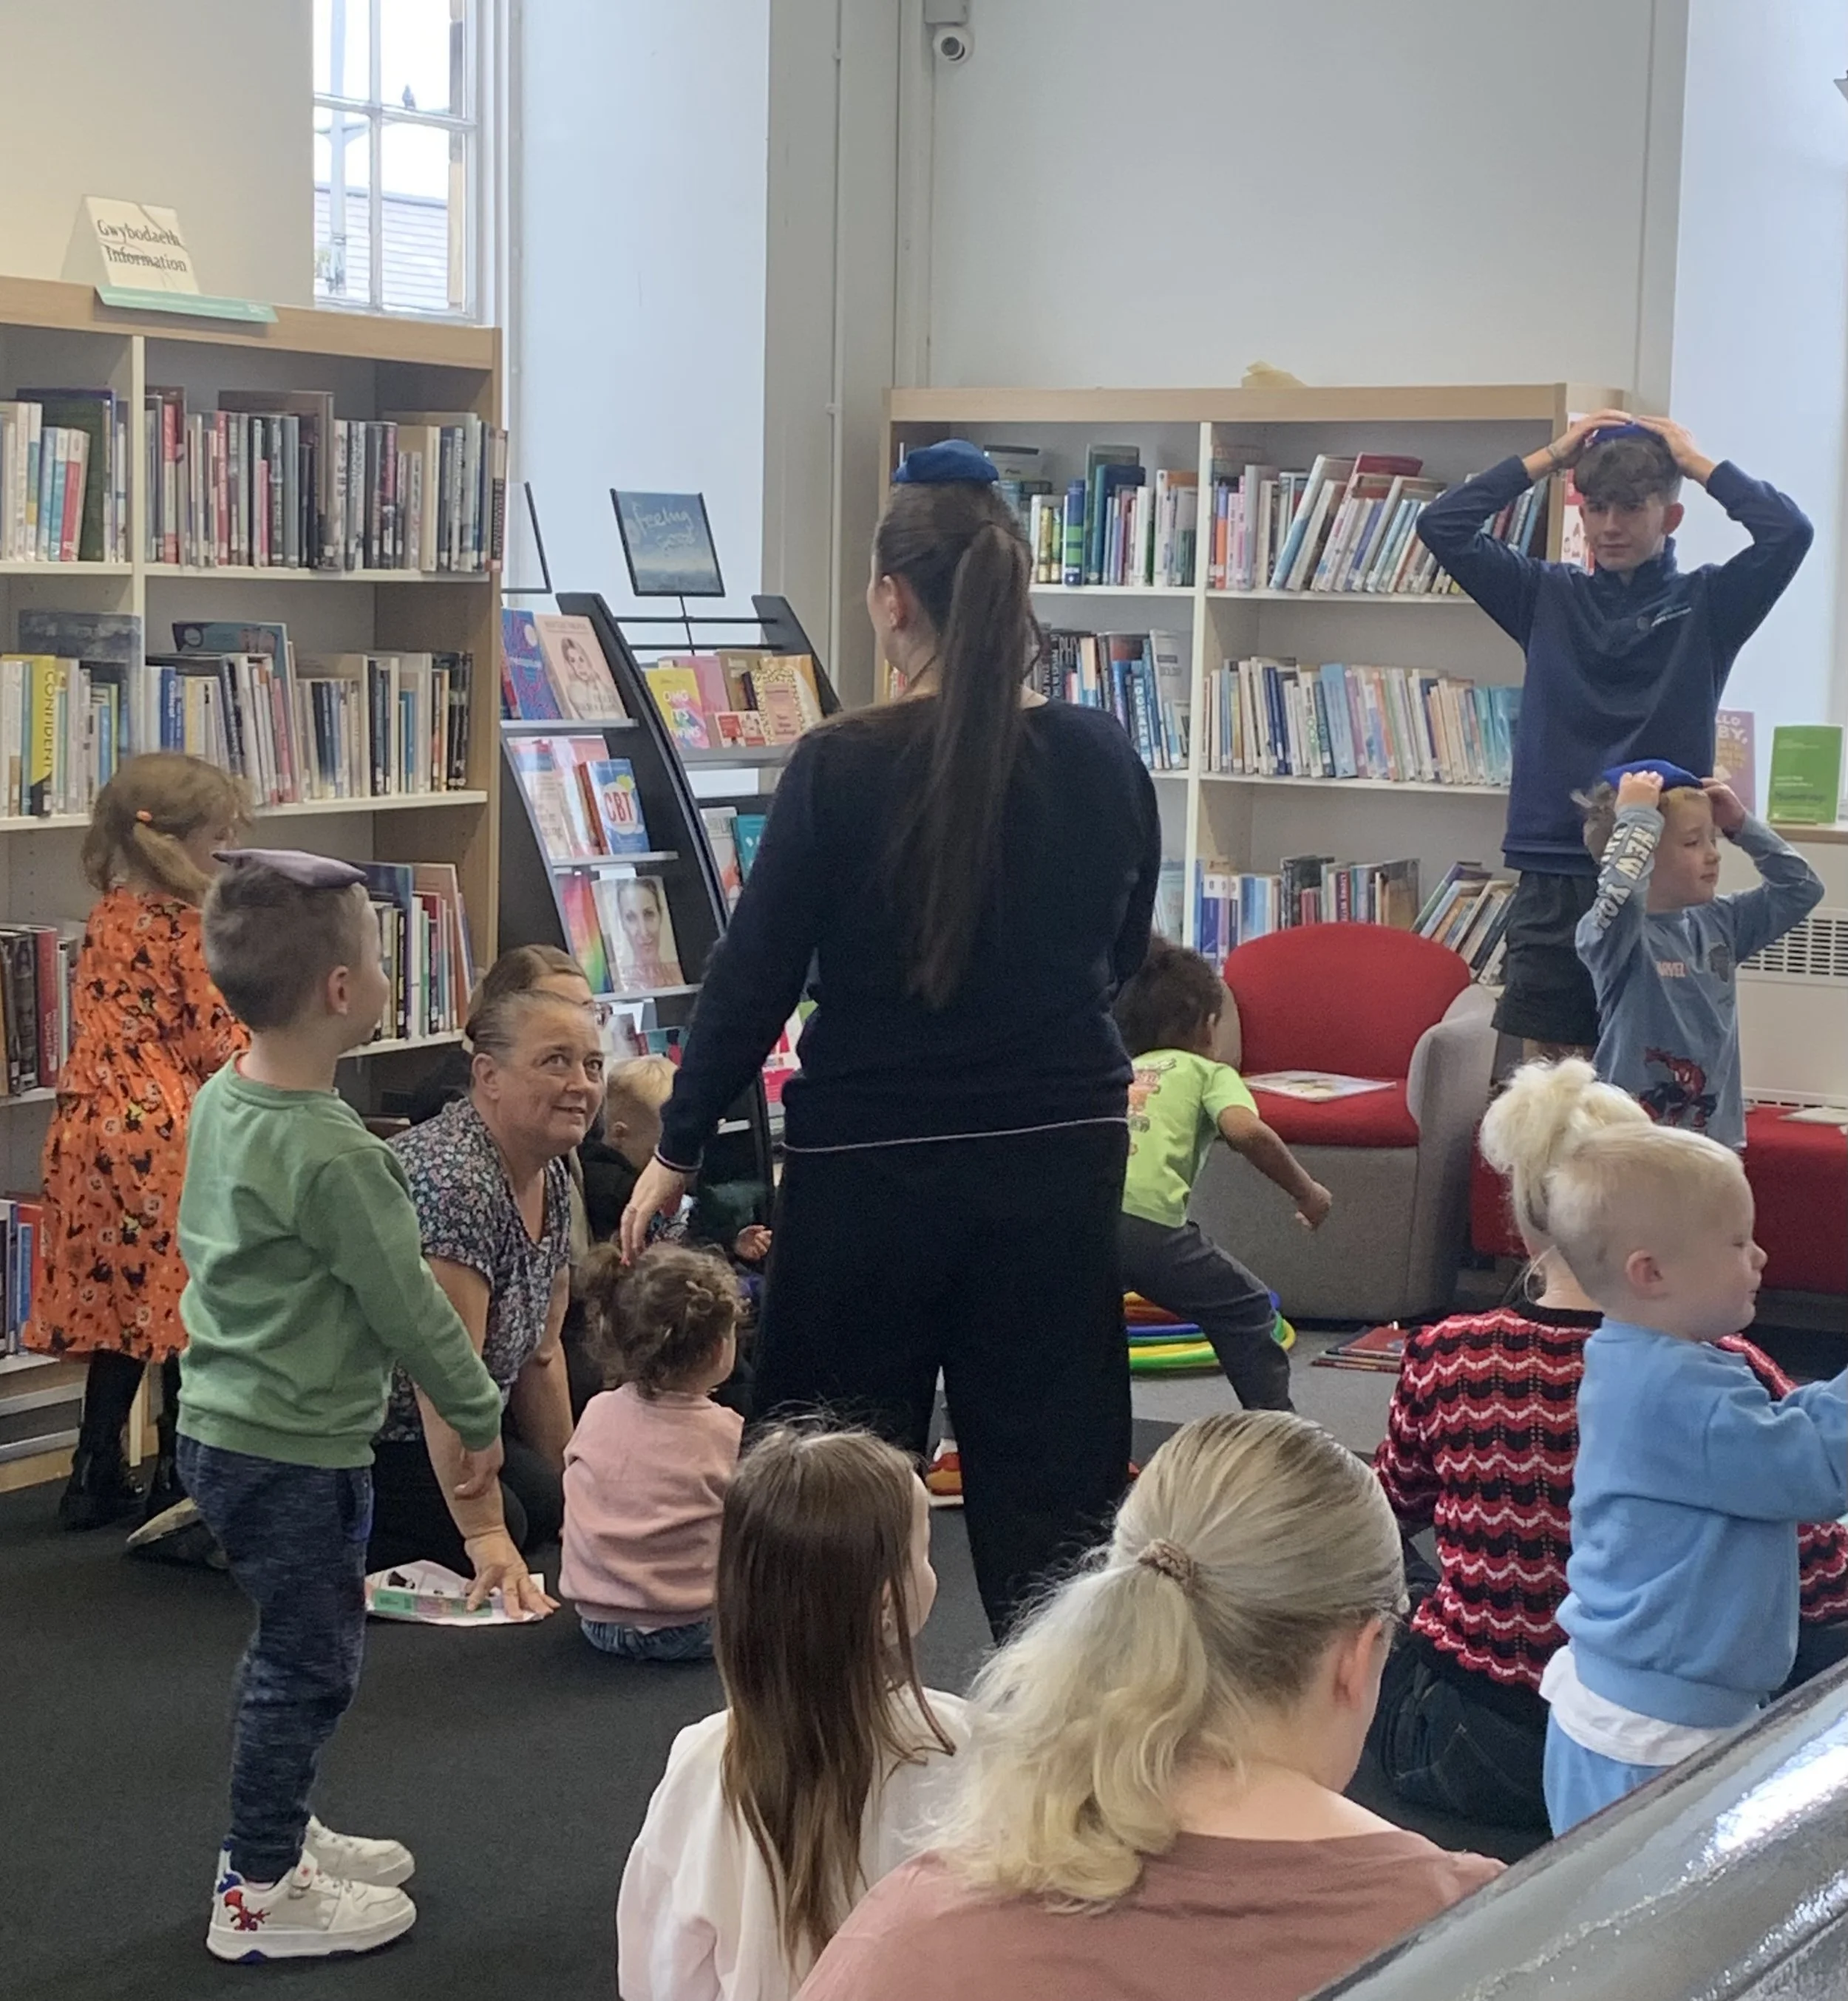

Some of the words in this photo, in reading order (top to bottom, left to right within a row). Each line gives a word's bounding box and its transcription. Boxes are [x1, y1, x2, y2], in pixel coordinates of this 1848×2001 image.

[97, 219, 181, 247] Gwybodaeth
[105, 245, 187, 273] Information
[44, 670, 54, 769] CONFIDENT
[1717, 724, 1748, 745] BY,
[603, 791, 633, 823] CBT
[1614, 826, 1657, 880] NEW
[1595, 883, 1632, 930] YOR
